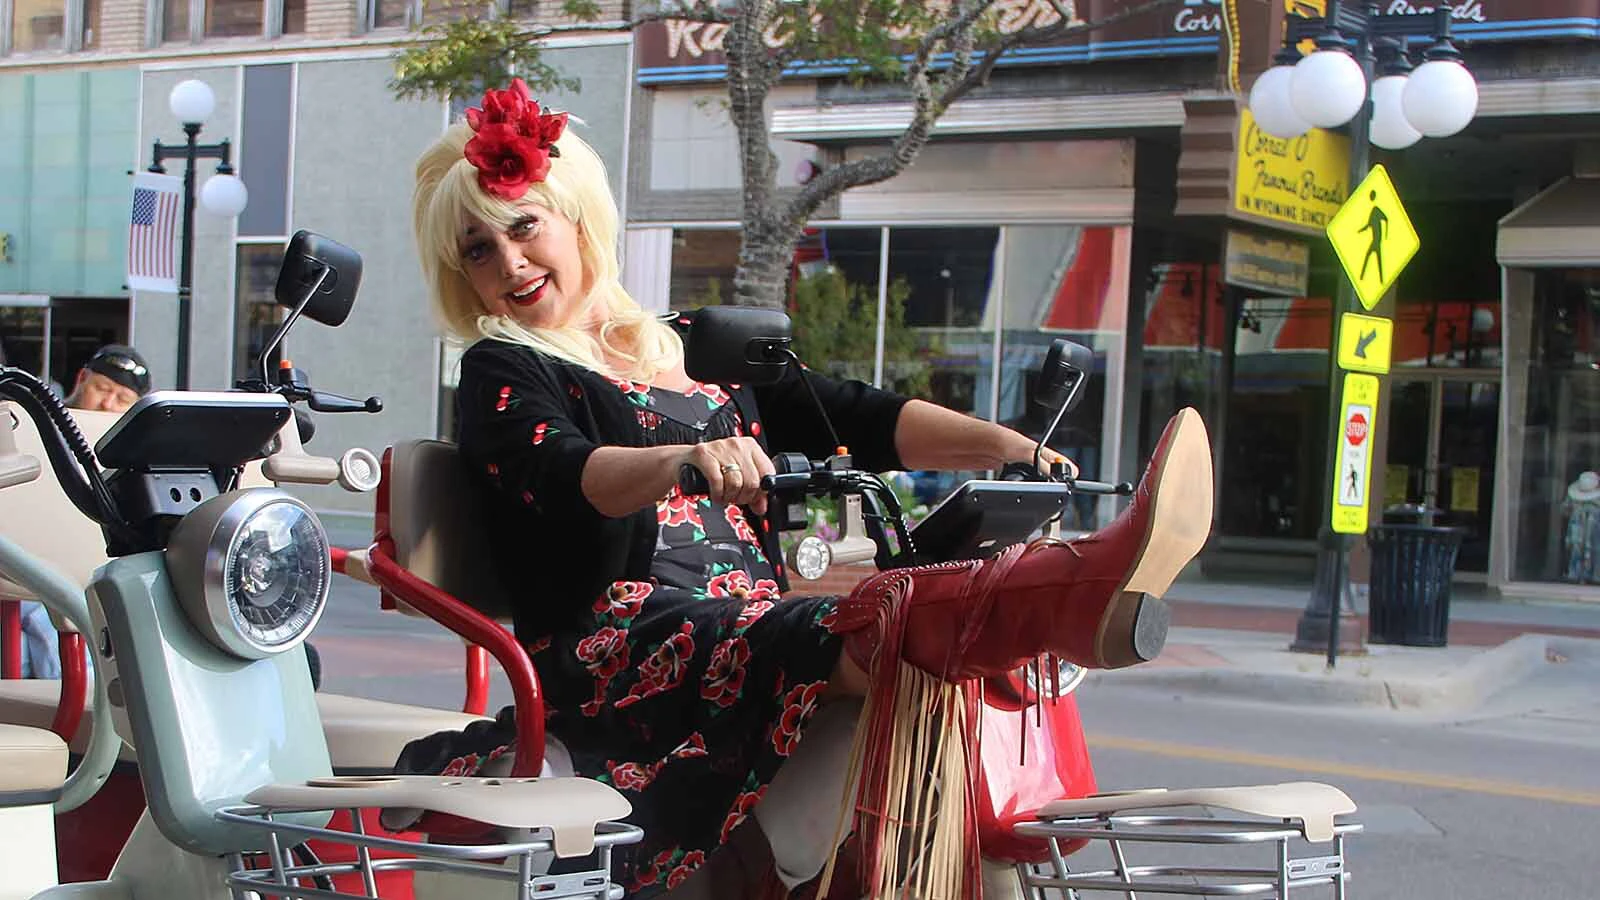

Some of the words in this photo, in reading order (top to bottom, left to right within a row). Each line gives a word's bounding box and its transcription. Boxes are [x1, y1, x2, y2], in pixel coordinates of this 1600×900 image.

[1253, 159, 1297, 196] Famous
[1255, 198, 1296, 220] WYOMING
[1346, 421, 1369, 437] STOP
